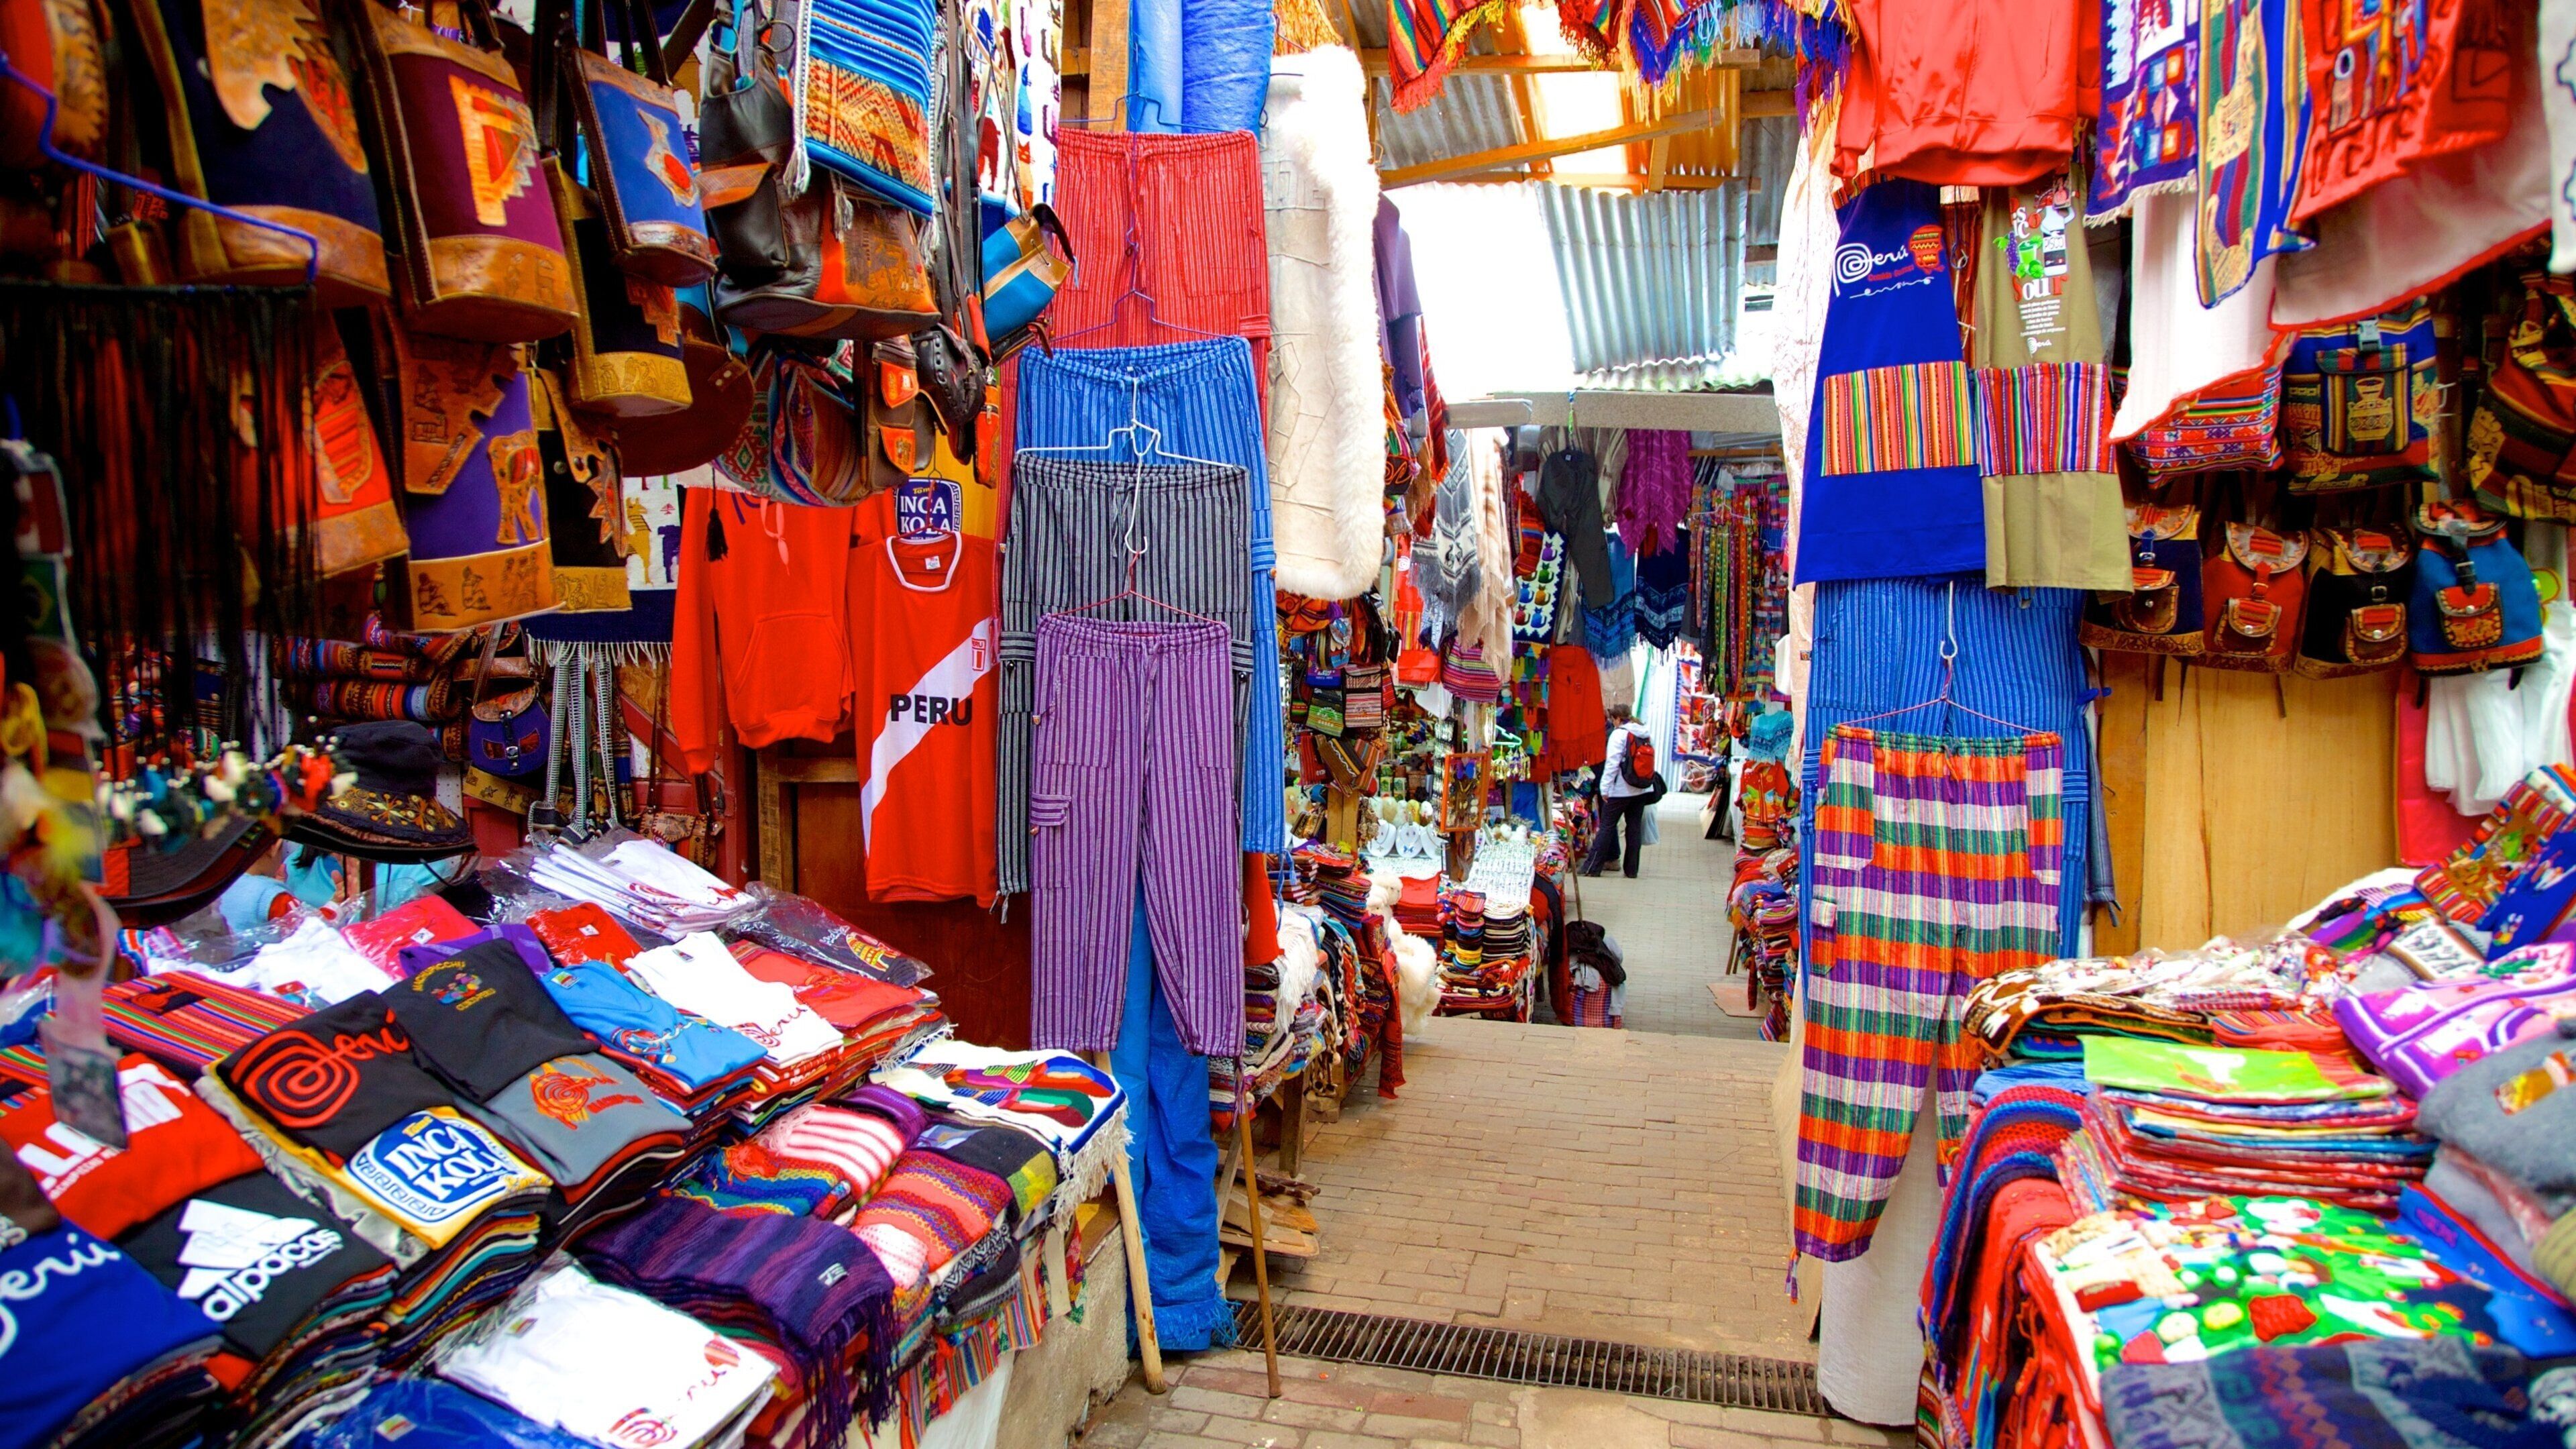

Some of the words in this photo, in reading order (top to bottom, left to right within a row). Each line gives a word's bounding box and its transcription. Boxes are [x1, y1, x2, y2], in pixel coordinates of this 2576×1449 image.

[2012, 274, 2069, 302] Sour
[900, 496, 947, 515] INCA
[900, 516, 951, 535] KOLA
[890, 694, 973, 727] PERU
[384, 1126, 478, 1179] INCA
[413, 1151, 506, 1201] KOL
[203, 1228, 343, 1322] alpacas
